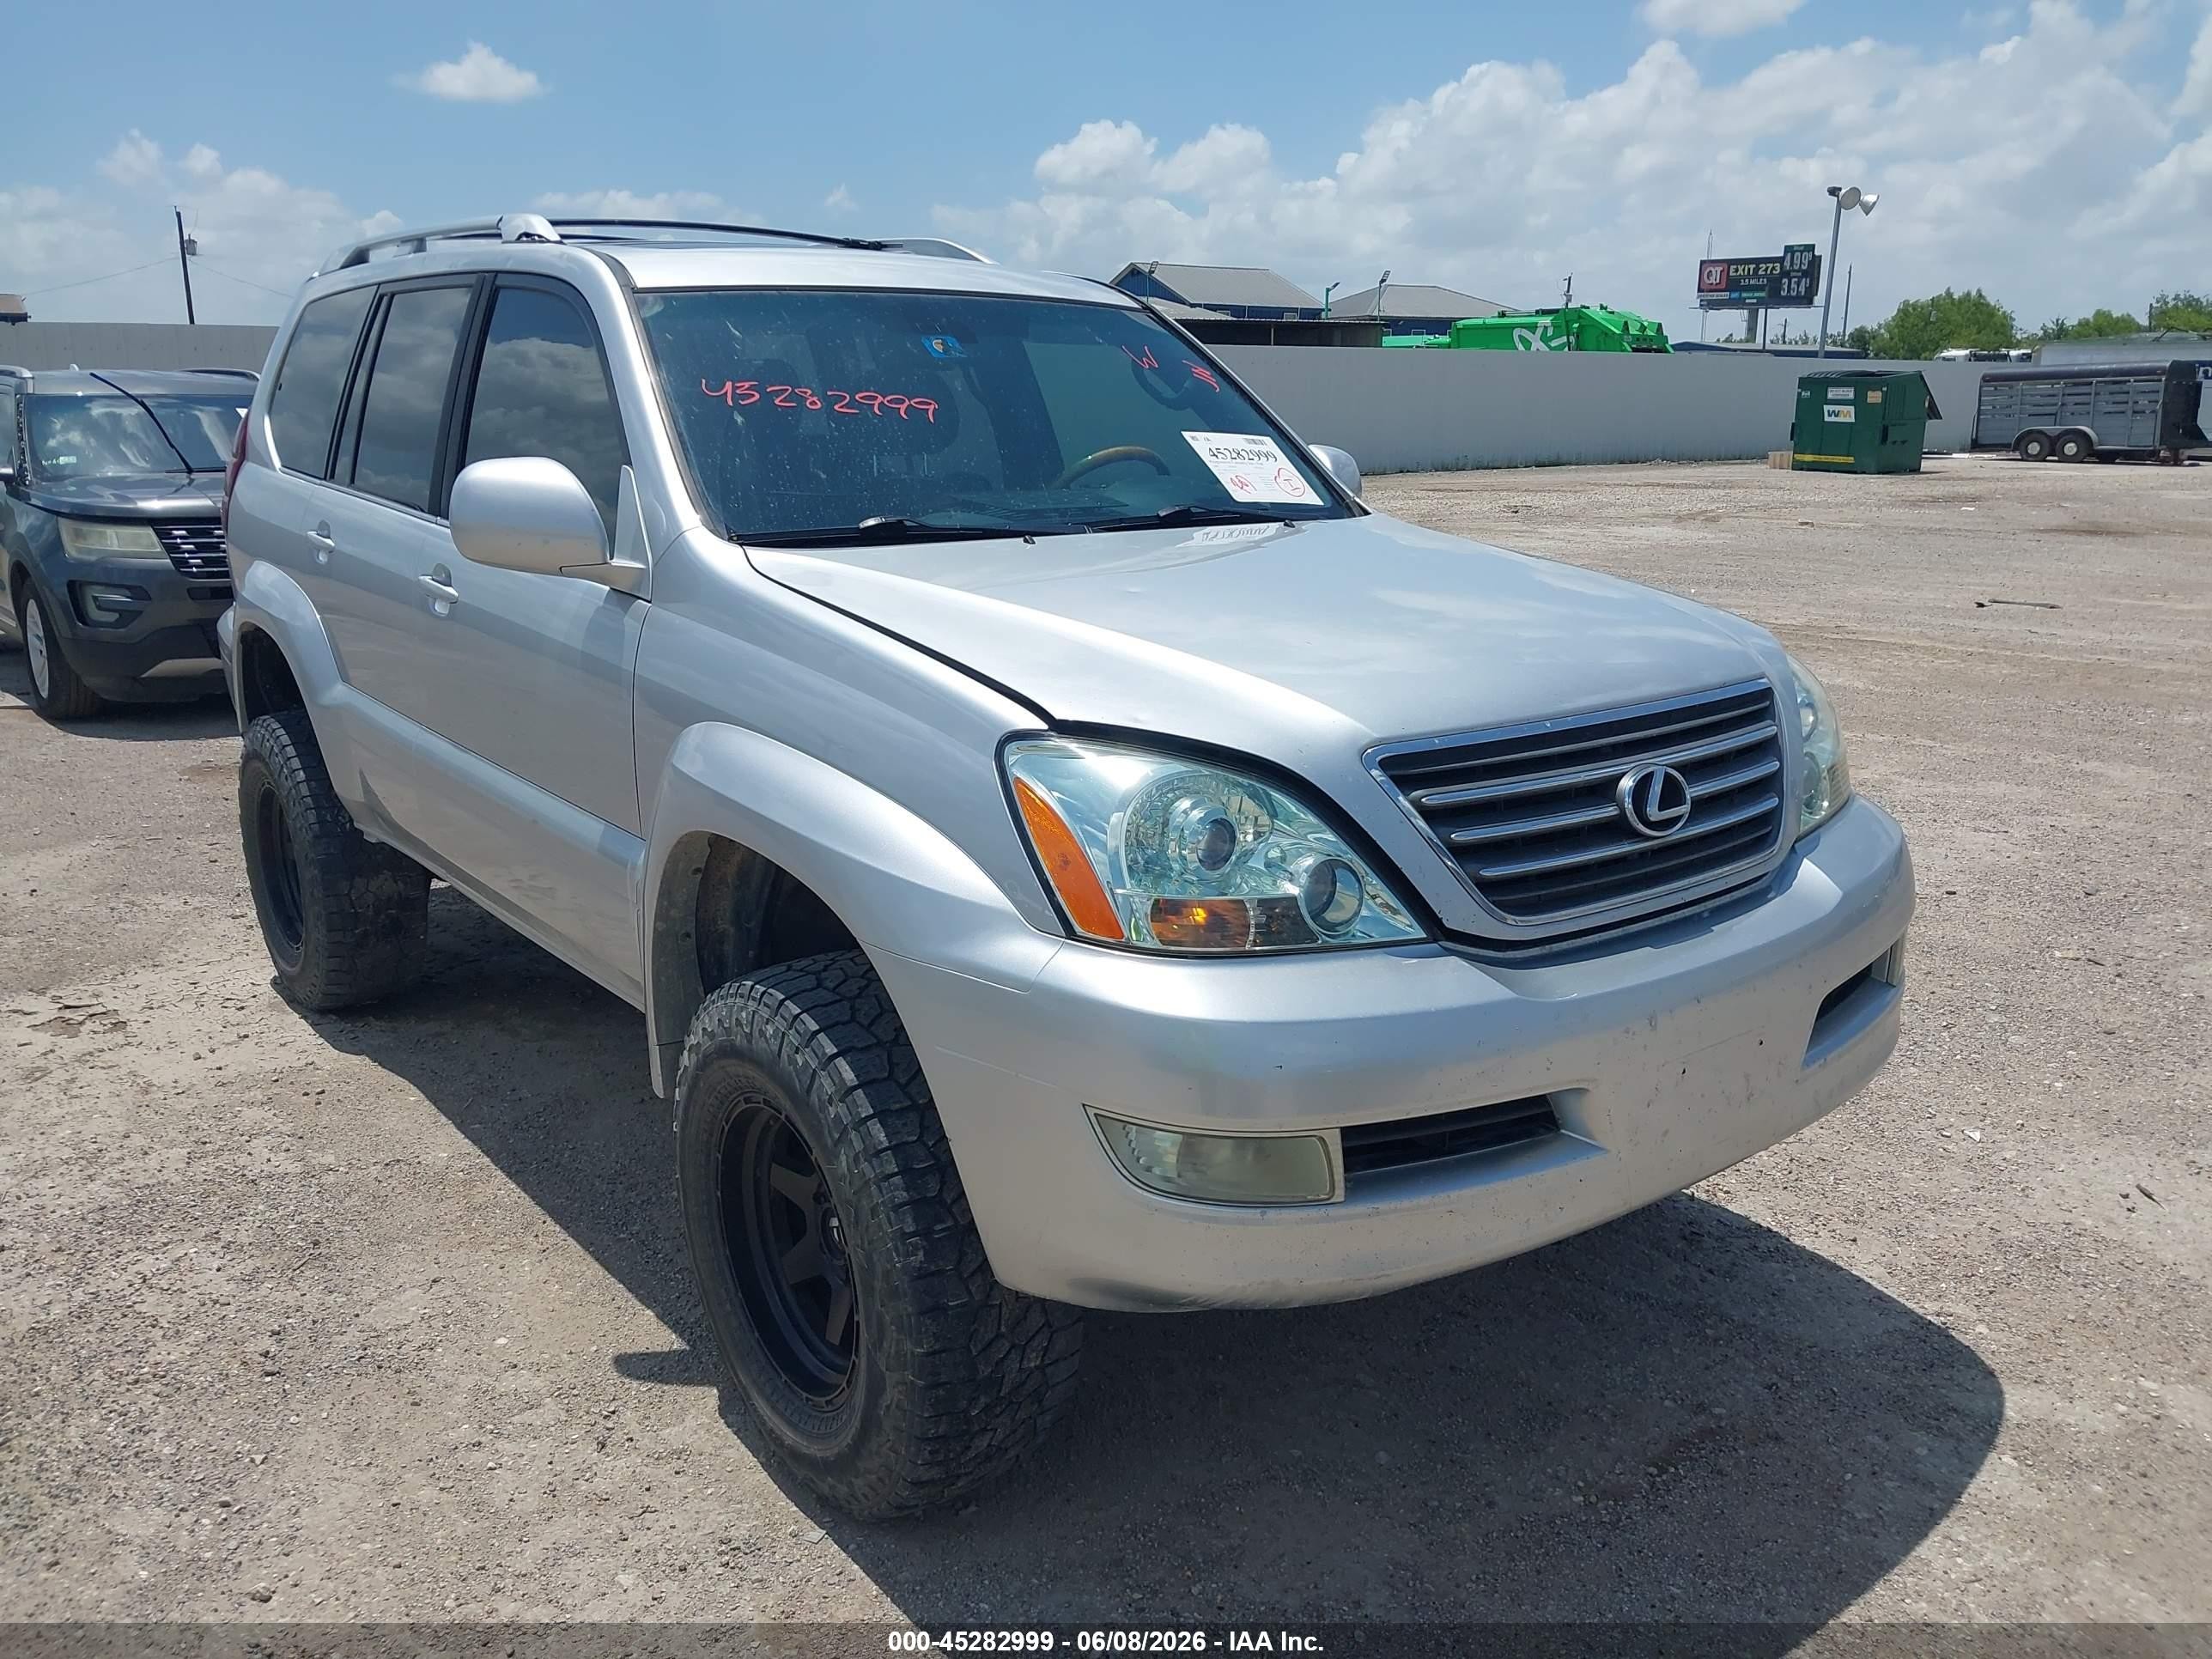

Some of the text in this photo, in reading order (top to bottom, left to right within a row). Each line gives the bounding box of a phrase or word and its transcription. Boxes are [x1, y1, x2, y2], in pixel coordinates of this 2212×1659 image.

[1704, 267, 1723, 285] QT
[1729, 264, 1756, 276] EXIT
[1758, 263, 1781, 275] 273
[1826, 410, 1852, 418] WM
[1208, 447, 1278, 463] 45282999
